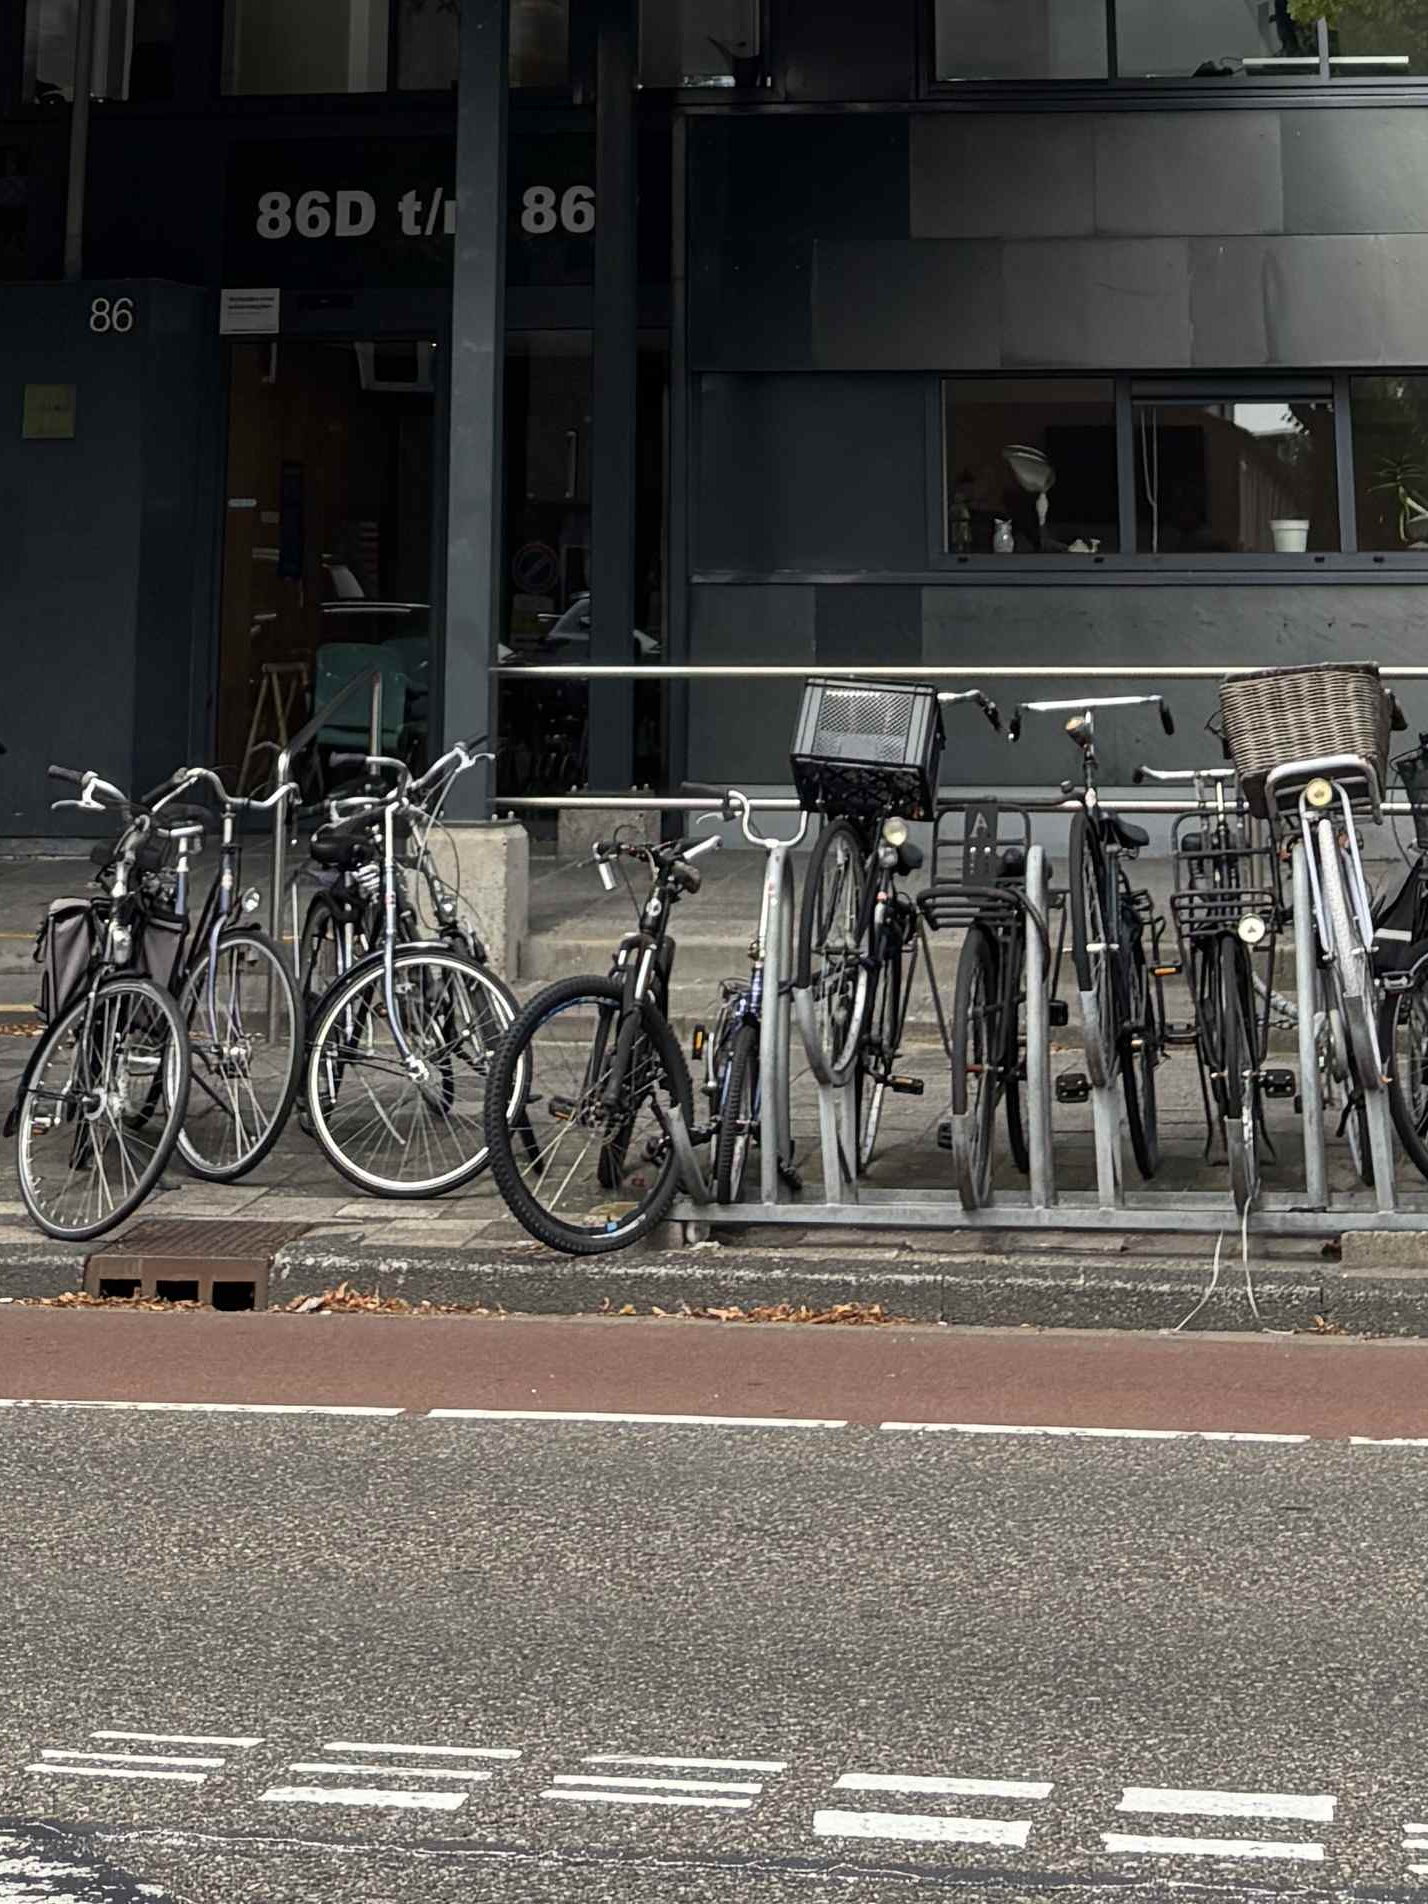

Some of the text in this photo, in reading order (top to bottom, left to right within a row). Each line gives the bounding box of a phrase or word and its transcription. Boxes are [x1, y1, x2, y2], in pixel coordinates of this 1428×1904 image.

[255, 185, 595, 239] 86D t/ 86
[89, 297, 133, 333] 86
